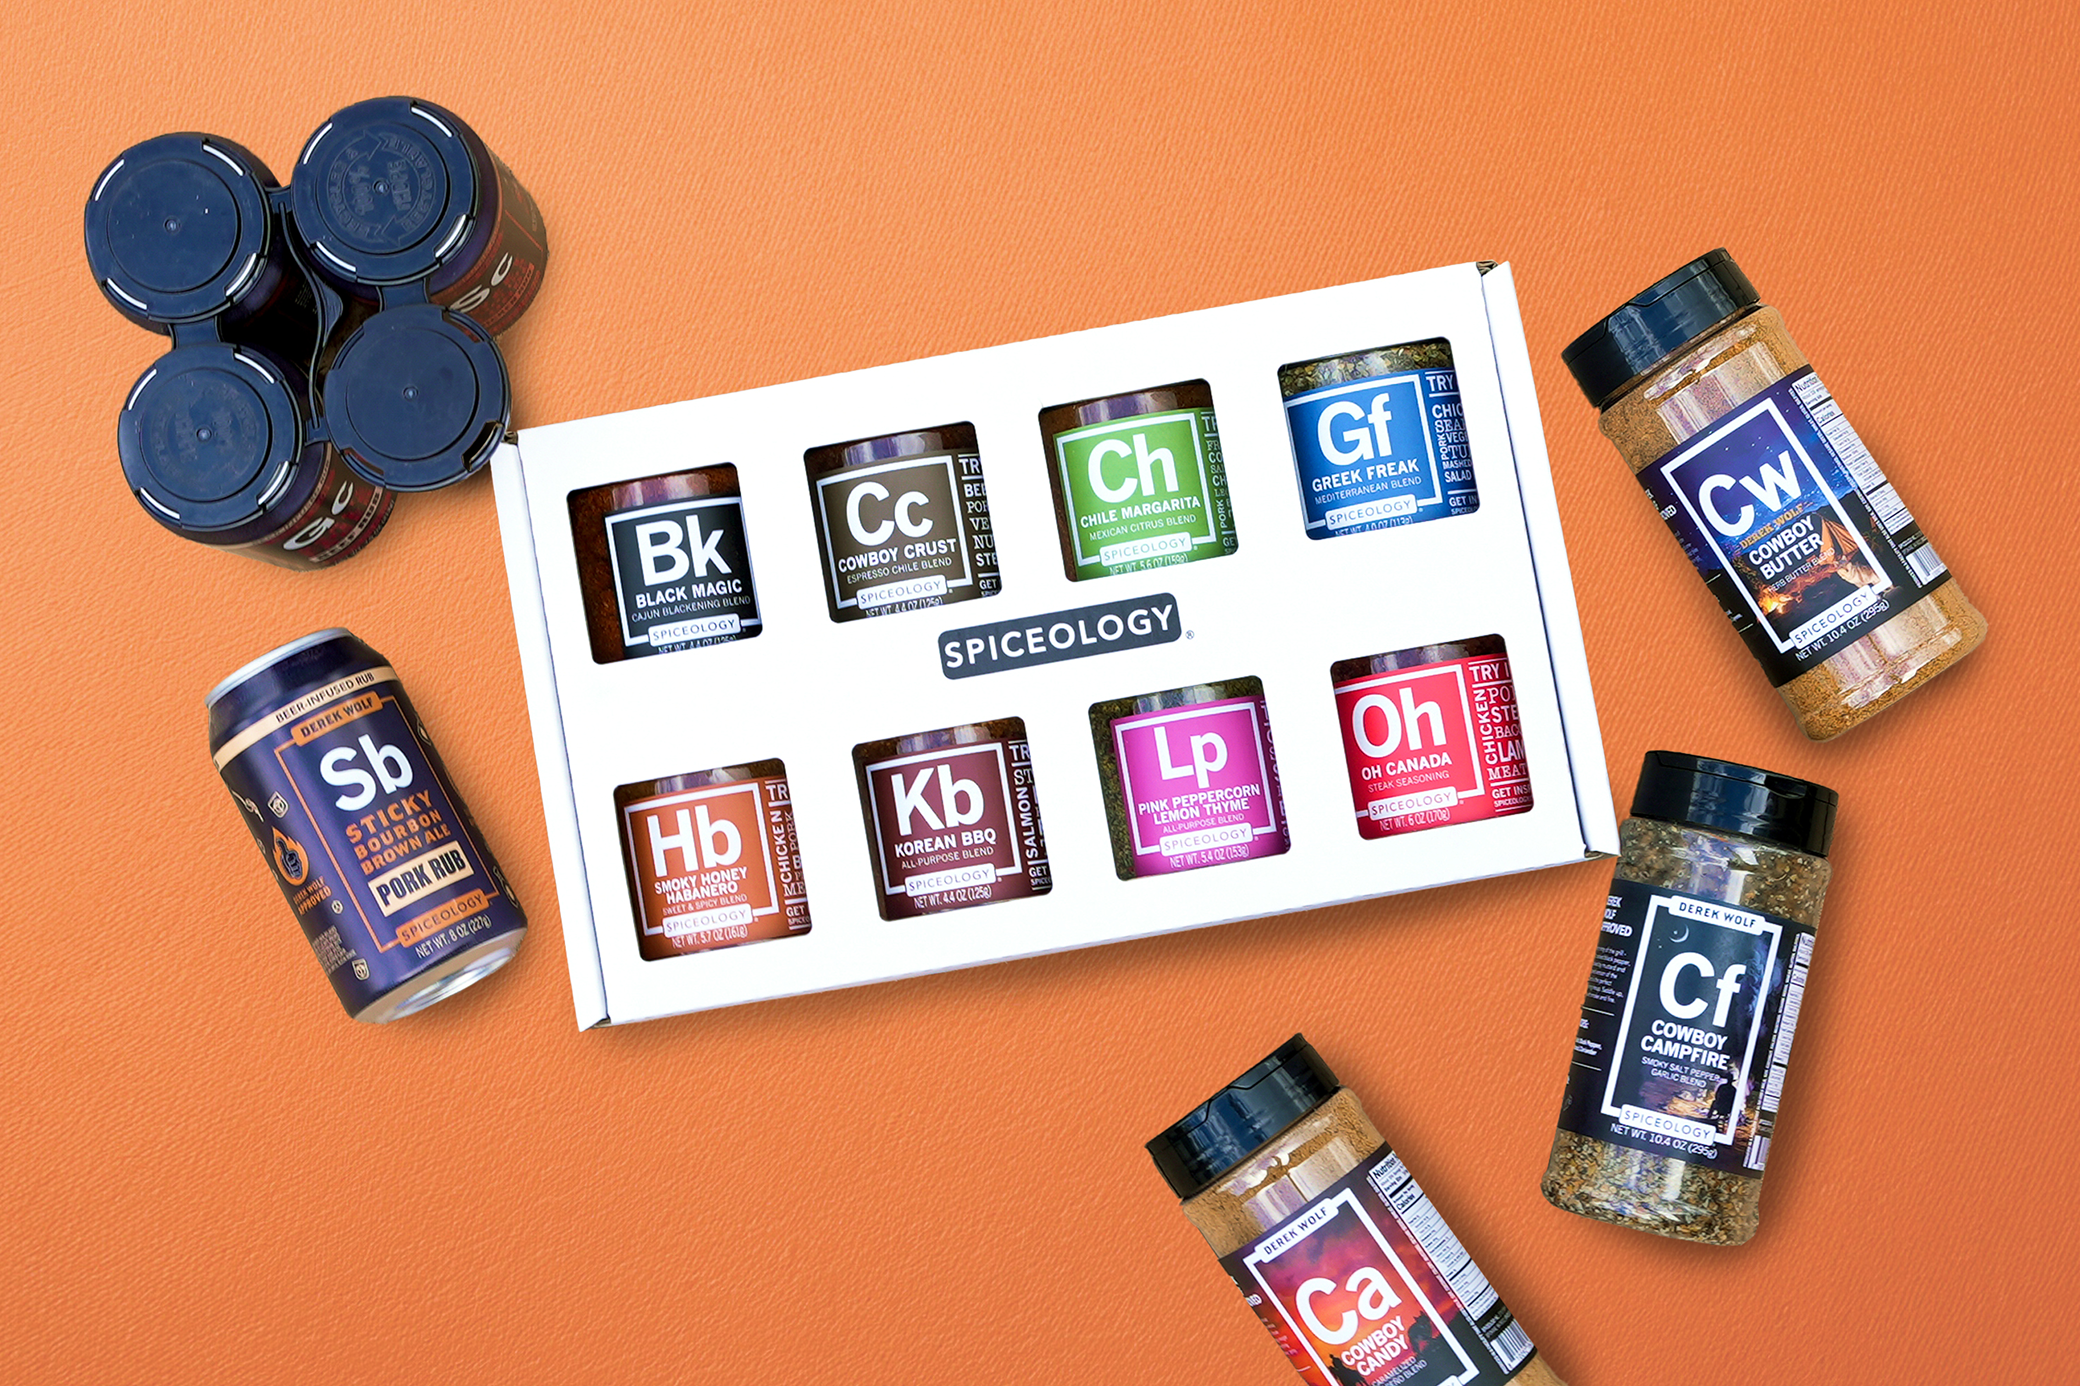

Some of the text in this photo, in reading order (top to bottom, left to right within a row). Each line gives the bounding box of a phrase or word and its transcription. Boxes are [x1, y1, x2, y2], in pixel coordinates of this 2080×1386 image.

[450, 252, 512, 313] Sc
[1425, 374, 1453, 392] TRY
[1317, 393, 1393, 466] Gf
[1436, 433, 1450, 460] PORK
[1087, 433, 1178, 503] Ch
[1312, 458, 1419, 492] GREEK FREAK
[1444, 470, 1472, 483] SALAD
[1314, 476, 1422, 505] MEDITERRANEAN BLEND
[1449, 496, 1467, 507] GET
[1698, 451, 1803, 538] Cw
[283, 480, 353, 550] Gc
[846, 481, 935, 546] Cc
[1080, 496, 1201, 528] CHILE MARGARITA
[1089, 514, 1196, 541] MEXICAN CITRUS BLEND
[1216, 500, 1228, 528] PORK
[1329, 500, 1411, 525] SPICEOLOGY
[1740, 503, 1804, 549] DEREK WOLF
[635, 514, 732, 586] Bk
[838, 538, 956, 572] COWBOY CRUST
[1104, 537, 1186, 561] SPICEOLOGY
[1749, 515, 1814, 565] COWBOY
[847, 557, 952, 584] ESPRESSO CHILE BLEND
[1760, 533, 1824, 580] BUTTER
[1785, 561, 1813, 582] BUTTER
[1811, 548, 1836, 566] BLEND
[635, 578, 742, 609] BLACK MAGIC
[860, 580, 940, 604] SPICEOLOGY
[979, 578, 997, 590] GET
[631, 595, 750, 623] CAJUN BLACKENING BLEND
[1794, 592, 1869, 643] SPICEOLOGY
[653, 619, 735, 641] SPICEOLOGY
[944, 604, 1172, 668] SPICEOLOGY
[1795, 647, 1813, 662] NET
[1827, 627, 1848, 643] 10.4
[1846, 616, 1862, 630] OZ
[1861, 599, 1890, 622] (295g)
[1469, 663, 1500, 682] TRY
[275, 672, 375, 723] BEER-INFUSED RUB
[300, 697, 374, 737] DEREK WOLF
[1352, 687, 1446, 759] Oh
[1473, 688, 1498, 765] CHICKEN
[320, 734, 413, 811] Sb
[1153, 726, 1228, 788] Lp
[1361, 752, 1452, 781] OH CANADA
[1368, 770, 1450, 793] STEAK SEASONING
[1492, 786, 1511, 799] GET
[890, 763, 986, 836] Kb
[1138, 784, 1261, 815] PINK PEPPERCORN
[1153, 798, 1250, 825] LEMON THYME
[1371, 792, 1451, 816] SPICEOLOGY
[345, 789, 432, 843] STICKY
[784, 810, 801, 853] PORK
[1015, 787, 1039, 859] SALMON
[1163, 813, 1245, 834] ALL-PURPOSE BLEND
[1380, 818, 1393, 832] NET
[1408, 814, 1415, 826] 6
[1414, 812, 1426, 825] OZ
[1425, 807, 1451, 823] (170g)
[354, 809, 442, 860] BOURBON
[360, 823, 451, 876] BROWN ALE
[647, 805, 742, 877] Hb
[770, 810, 793, 883] CHICKEN
[895, 828, 997, 858] KOREAN BBQ
[1164, 828, 1247, 851] SPICEOLOGY
[901, 846, 994, 870] ALL-PURPOSE BLEND
[1028, 865, 1047, 877] GET
[1169, 855, 1184, 869] NET
[1201, 851, 1214, 863] 5.4
[1214, 848, 1225, 861] OZ
[1226, 844, 1250, 859] (153g)
[376, 849, 466, 907] PORK RUB
[654, 866, 747, 895] SMOKY HONEY
[666, 881, 738, 905] HABANERO
[909, 869, 990, 891] SPICEOLOGY
[662, 894, 748, 916] SWEET & SPICY BLEND
[786, 905, 805, 917] GET
[913, 895, 927, 909] NET
[943, 891, 956, 904] 4.4
[956, 889, 968, 902] OZ
[968, 884, 992, 901] (125g)
[401, 893, 483, 941] SPICEOLOGY
[666, 909, 747, 932] SPICEOLOGY
[1679, 902, 1756, 928] DEREK WOLF
[415, 941, 434, 959] NET
[450, 928, 458, 942] 8
[457, 924, 470, 939] OZ
[468, 914, 492, 935] (227g)
[671, 935, 685, 949] NET
[701, 929, 712, 943] 5.7
[713, 927, 725, 941] OZ
[1659, 951, 1746, 1028] Cf
[1651, 1019, 1728, 1051] COWBOY
[1641, 1035, 1730, 1070] CAMPFIRE
[1641, 1056, 1720, 1082] SMOKY SALT PEPPER
[1651, 1068, 1707, 1088] GARLIC BLEND
[1624, 1110, 1711, 1139] SPICEOLOGY
[1610, 1123, 1630, 1135] NET
[1649, 1133, 1671, 1146] 10.4
[1672, 1139, 1688, 1151] OZ
[1687, 1142, 1718, 1159] (295g)
[1263, 1206, 1327, 1255] DEREK WOLF
[1295, 1266, 1402, 1345] Ca
[1341, 1315, 1405, 1366] COWBOY
[1356, 1334, 1409, 1376] CANDY
[1404, 1359, 1428, 1380] BLEND
